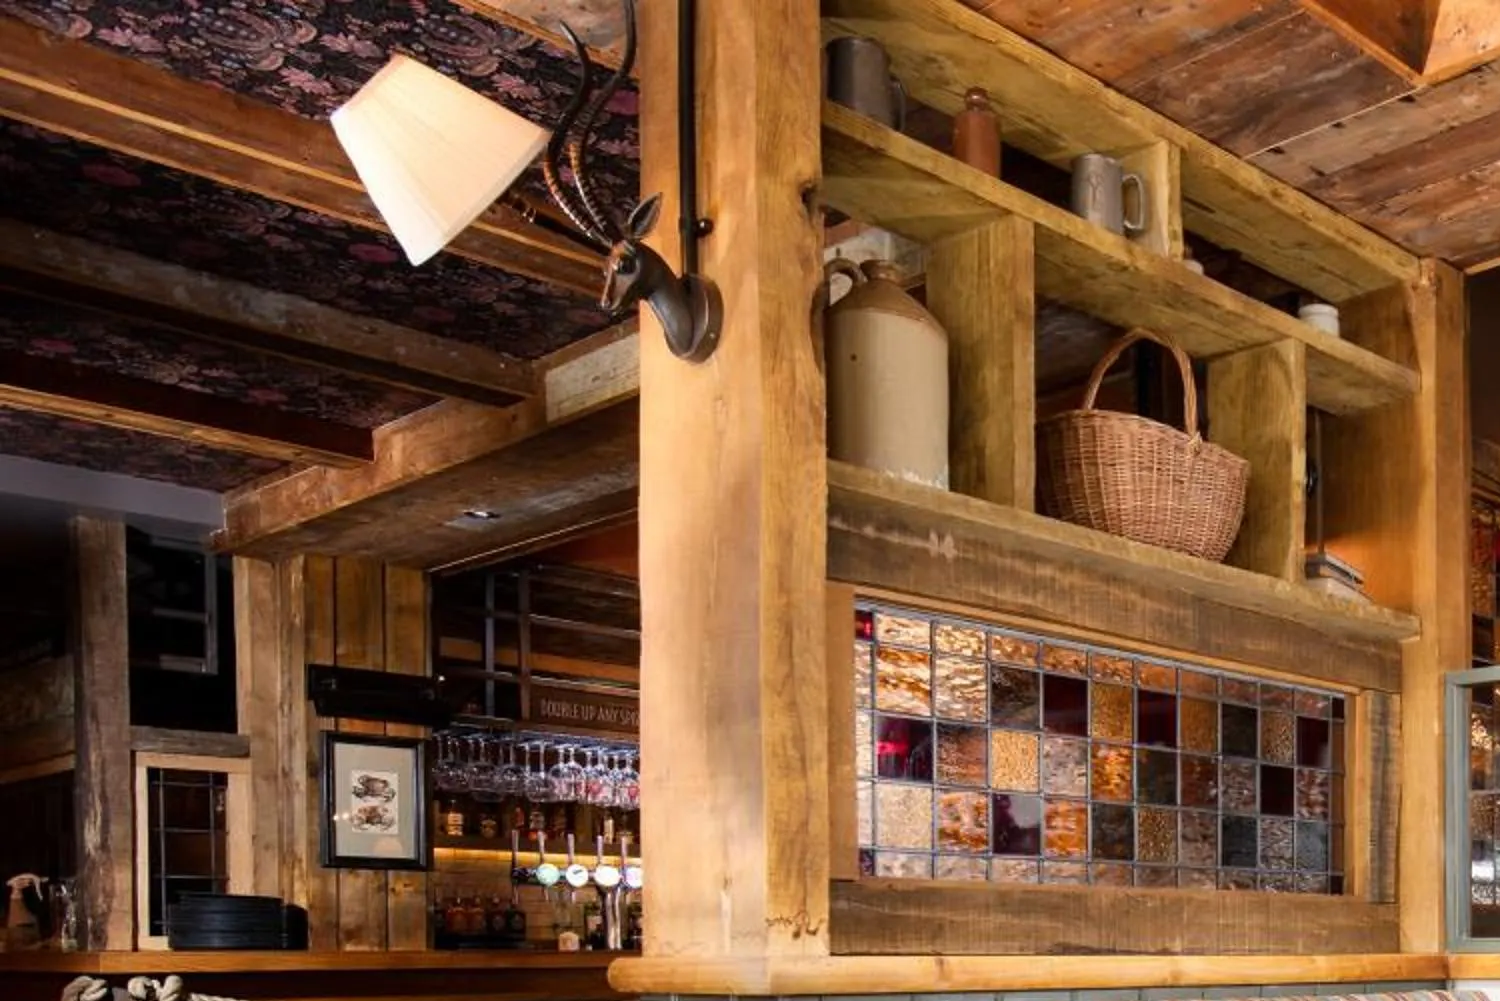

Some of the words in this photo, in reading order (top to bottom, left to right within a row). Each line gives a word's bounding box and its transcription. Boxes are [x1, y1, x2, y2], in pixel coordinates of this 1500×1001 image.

[540, 699, 579, 718] DOUBLE
[581, 703, 597, 721] UP
[597, 704, 619, 722] ANY
